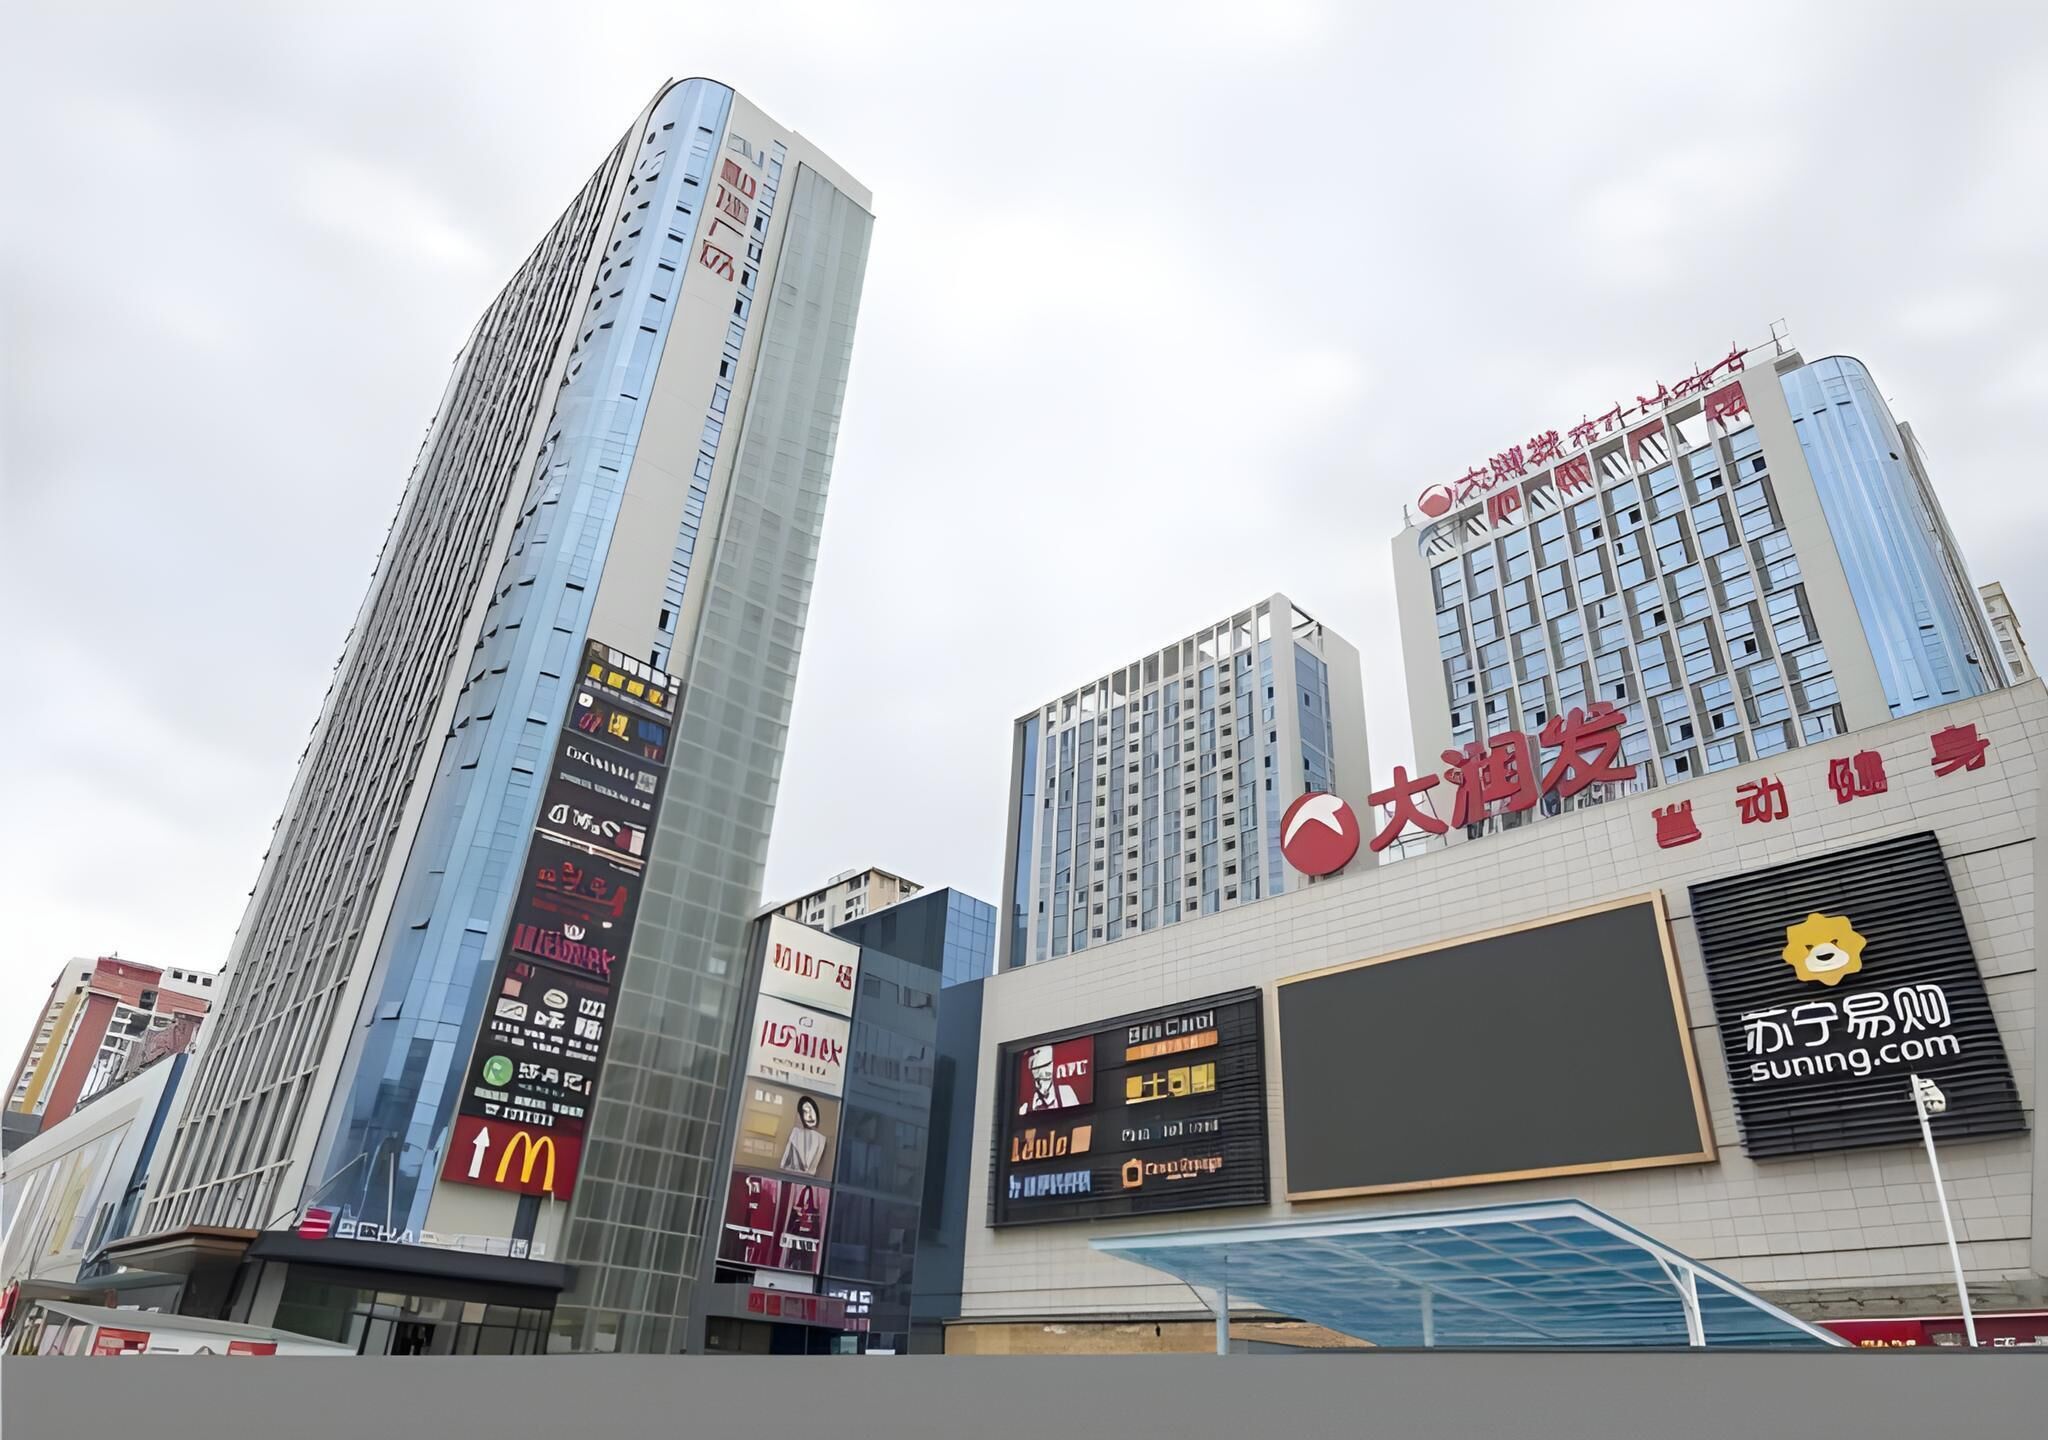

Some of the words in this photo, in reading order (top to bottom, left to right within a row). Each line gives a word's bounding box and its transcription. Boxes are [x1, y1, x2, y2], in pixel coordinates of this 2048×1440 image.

[1367, 701, 1637, 853] 大润发
[1741, 984, 1951, 1055] 苏宁易购
[1751, 1034, 1961, 1082] suning.com
